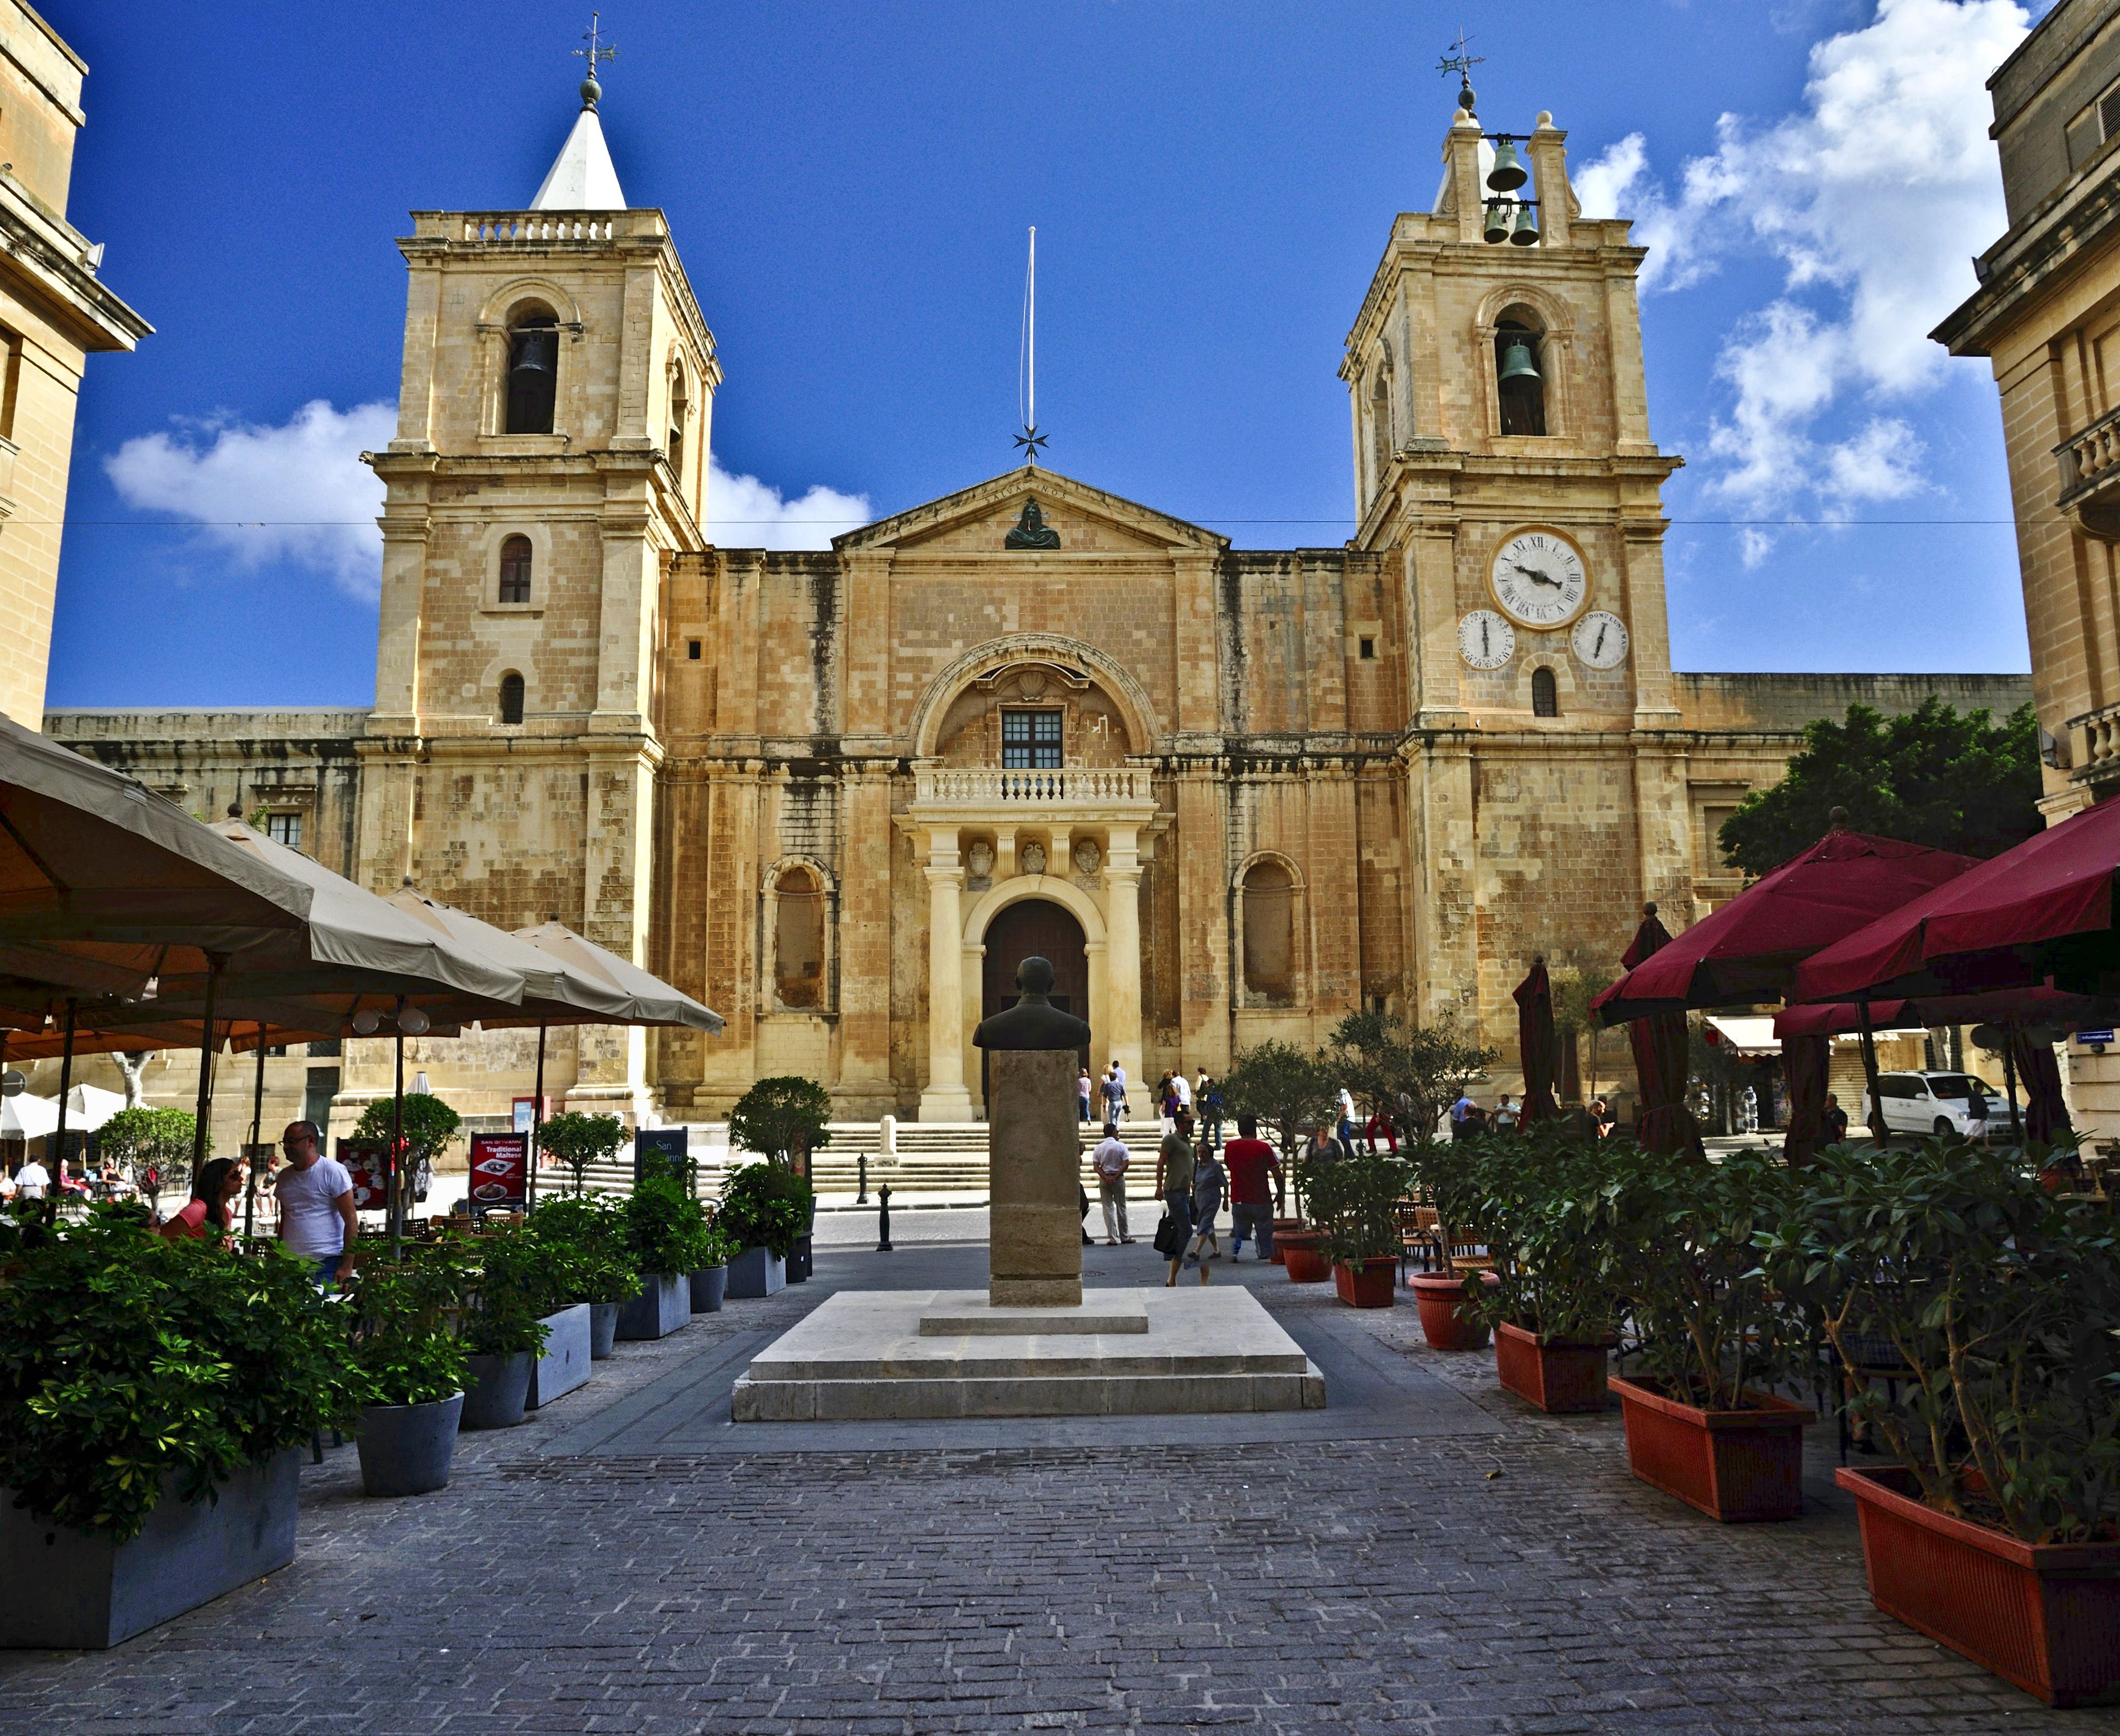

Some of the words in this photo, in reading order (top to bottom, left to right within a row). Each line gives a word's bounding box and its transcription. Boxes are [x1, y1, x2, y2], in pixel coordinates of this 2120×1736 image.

[1513, 541, 1526, 550] XI
[1530, 537, 1543, 547] XII
[1553, 542, 1559, 552] I
[1501, 554, 1513, 564] X
[1566, 555, 1575, 564] II
[1570, 574, 1581, 582] III
[1565, 588, 1578, 602] IIII
[1536, 608, 1546, 618] VI
[1557, 605, 1565, 615] V
[656, 1140, 671, 1150] San
